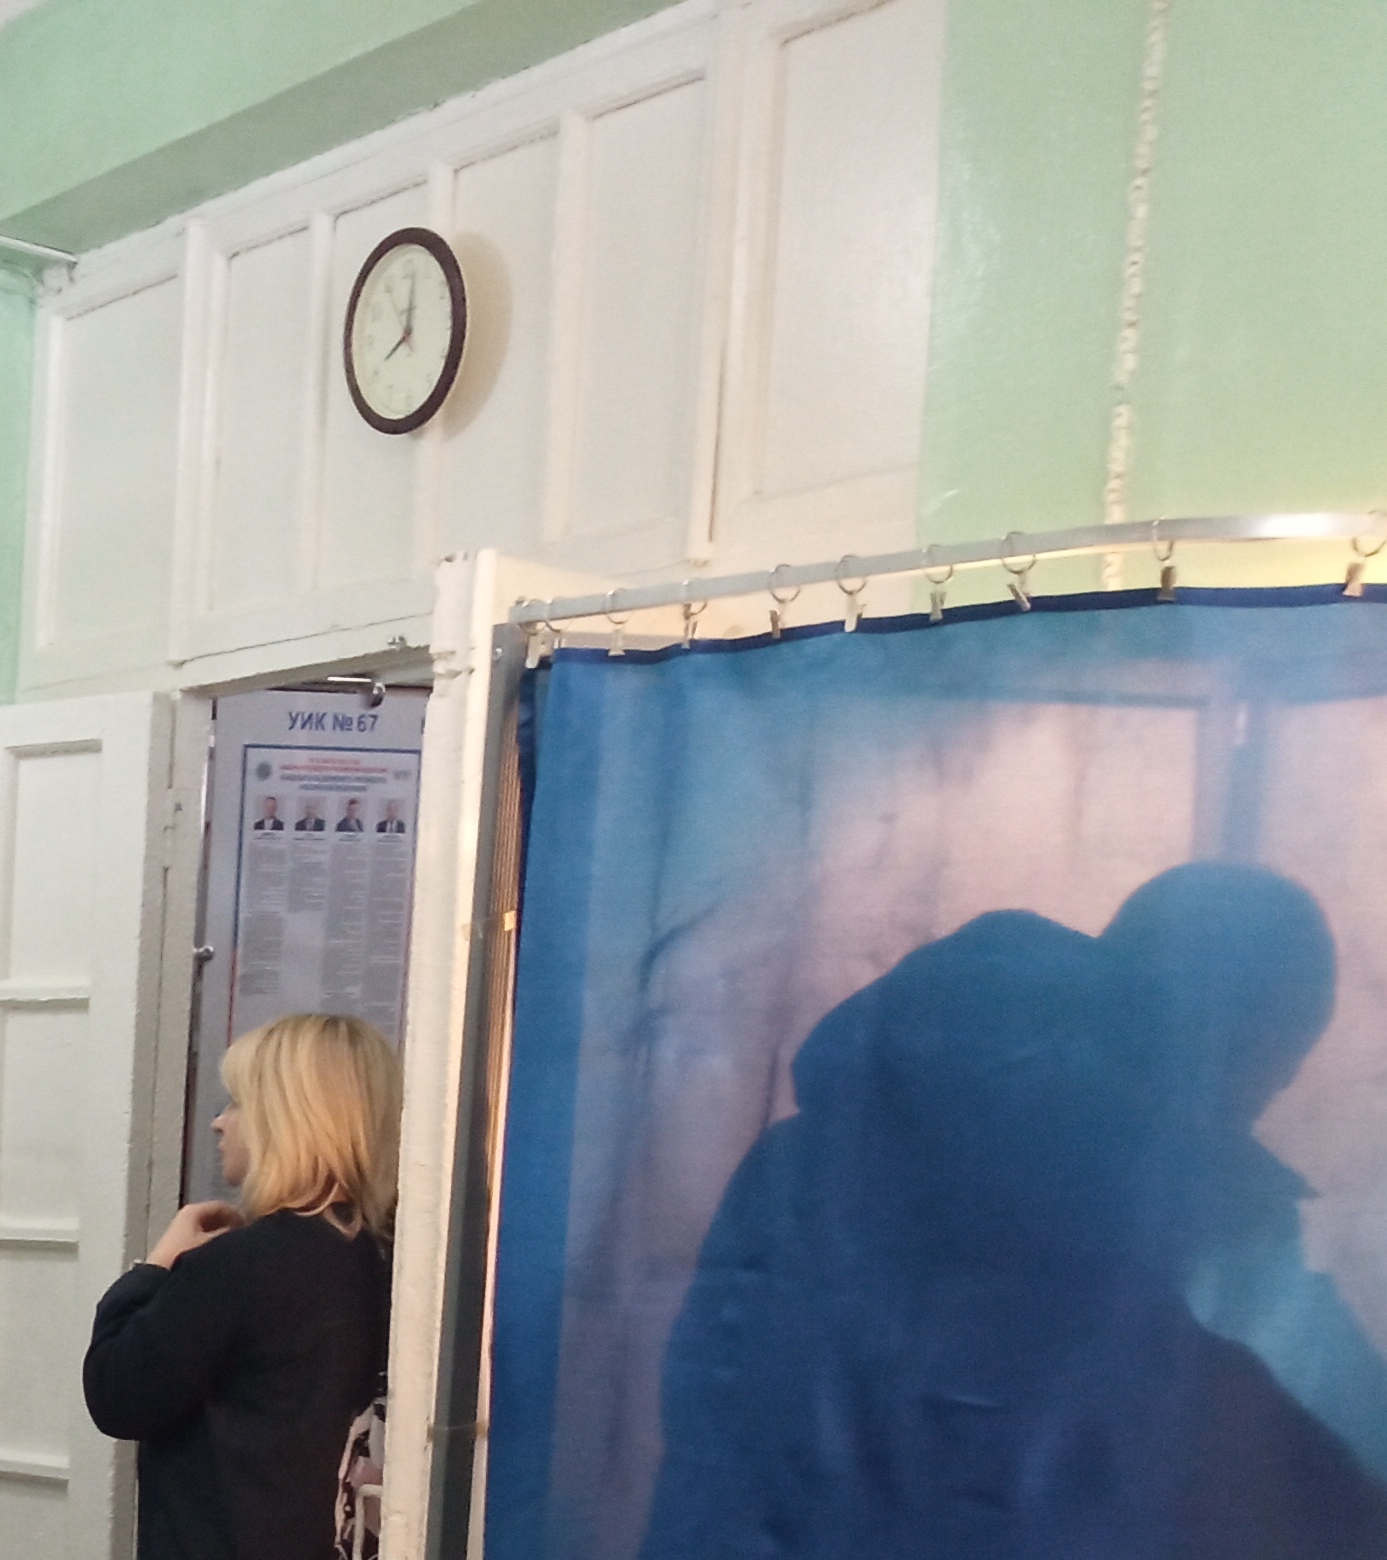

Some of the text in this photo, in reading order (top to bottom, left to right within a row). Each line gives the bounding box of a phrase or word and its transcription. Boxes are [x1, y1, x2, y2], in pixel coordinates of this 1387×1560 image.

[287, 711, 379, 733] УИК № 67
